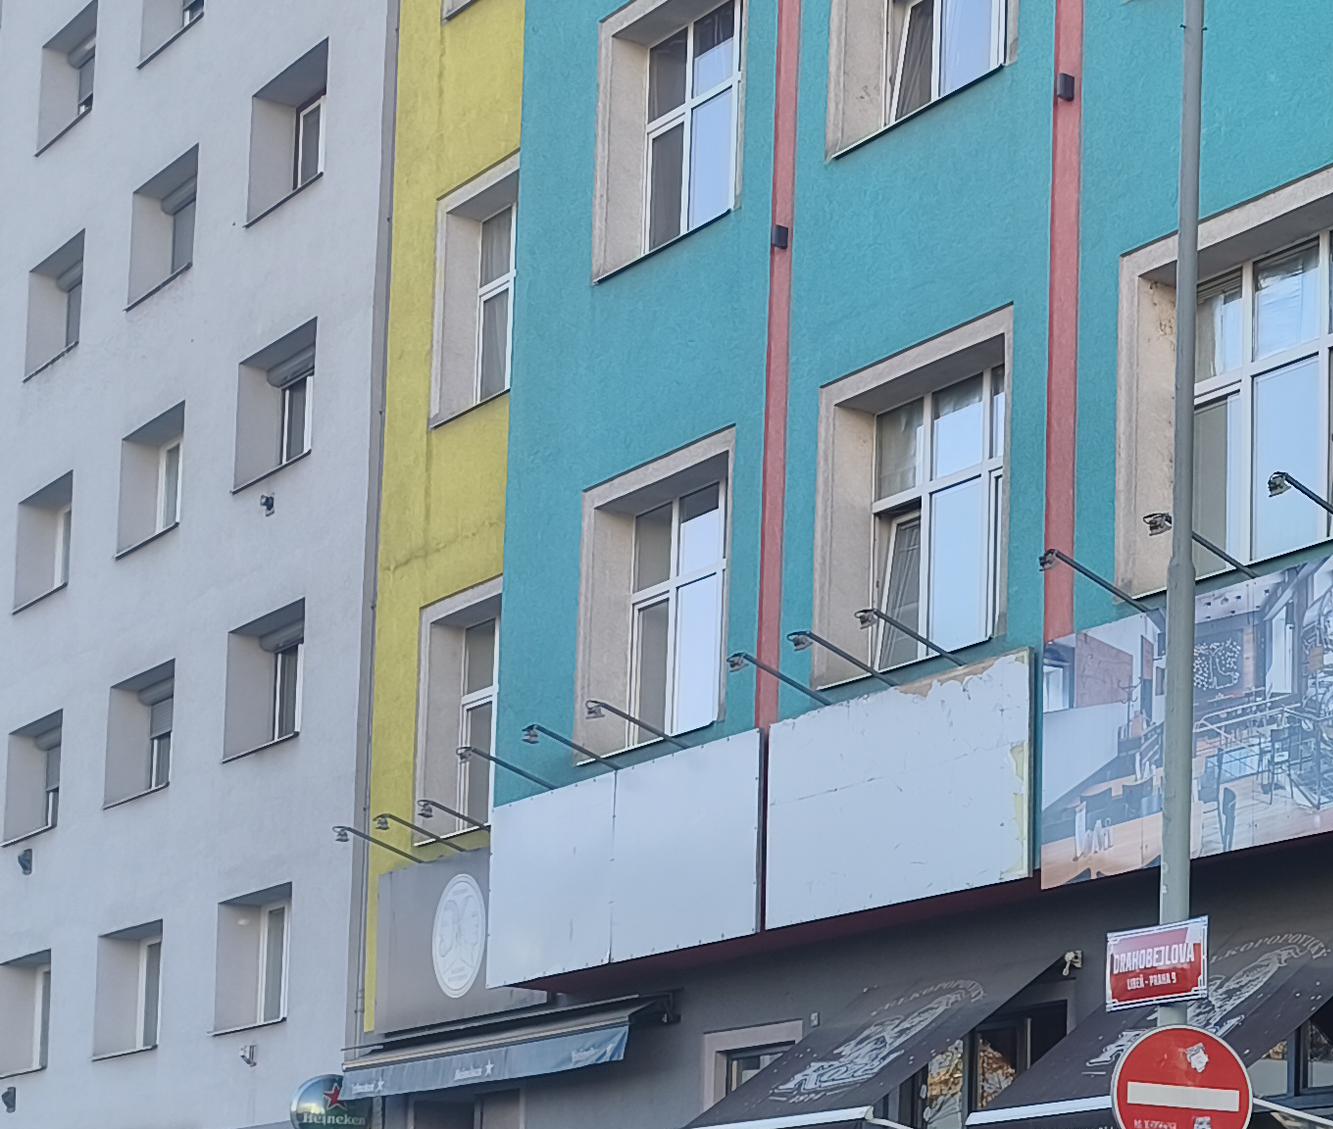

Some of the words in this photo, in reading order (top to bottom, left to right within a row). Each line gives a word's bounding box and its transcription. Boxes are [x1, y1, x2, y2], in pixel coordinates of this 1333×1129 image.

[1112, 942, 1195, 974] DRAHOBEJLOVA
[1126, 973, 1144, 990] LIBEŇ
[1149, 974, 1170, 987] PRAHA
[1171, 972, 1177, 984] 9
[302, 1112, 366, 1125] Heineken
